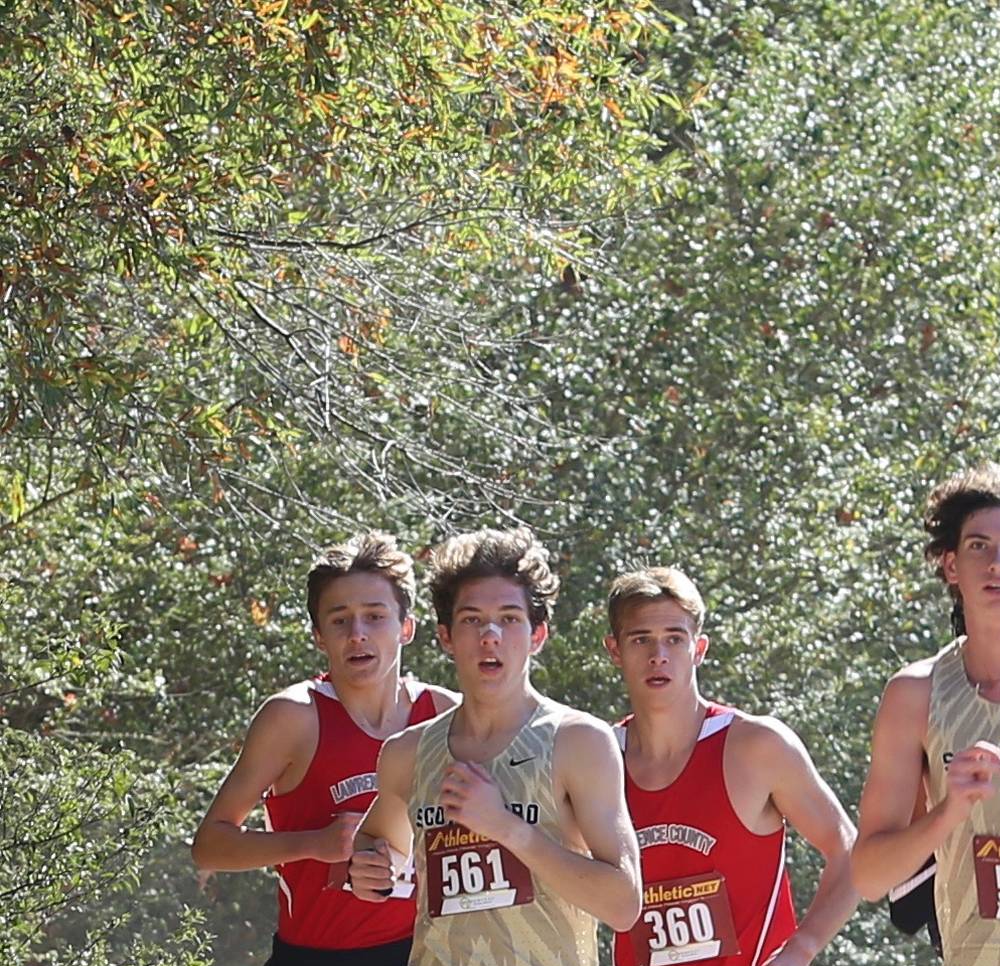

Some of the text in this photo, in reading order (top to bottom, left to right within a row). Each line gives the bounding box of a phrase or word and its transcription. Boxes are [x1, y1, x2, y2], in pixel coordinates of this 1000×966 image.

[668, 823, 718, 857] COUNTY
[441, 847, 511, 898] 561
[643, 902, 715, 950] 360
